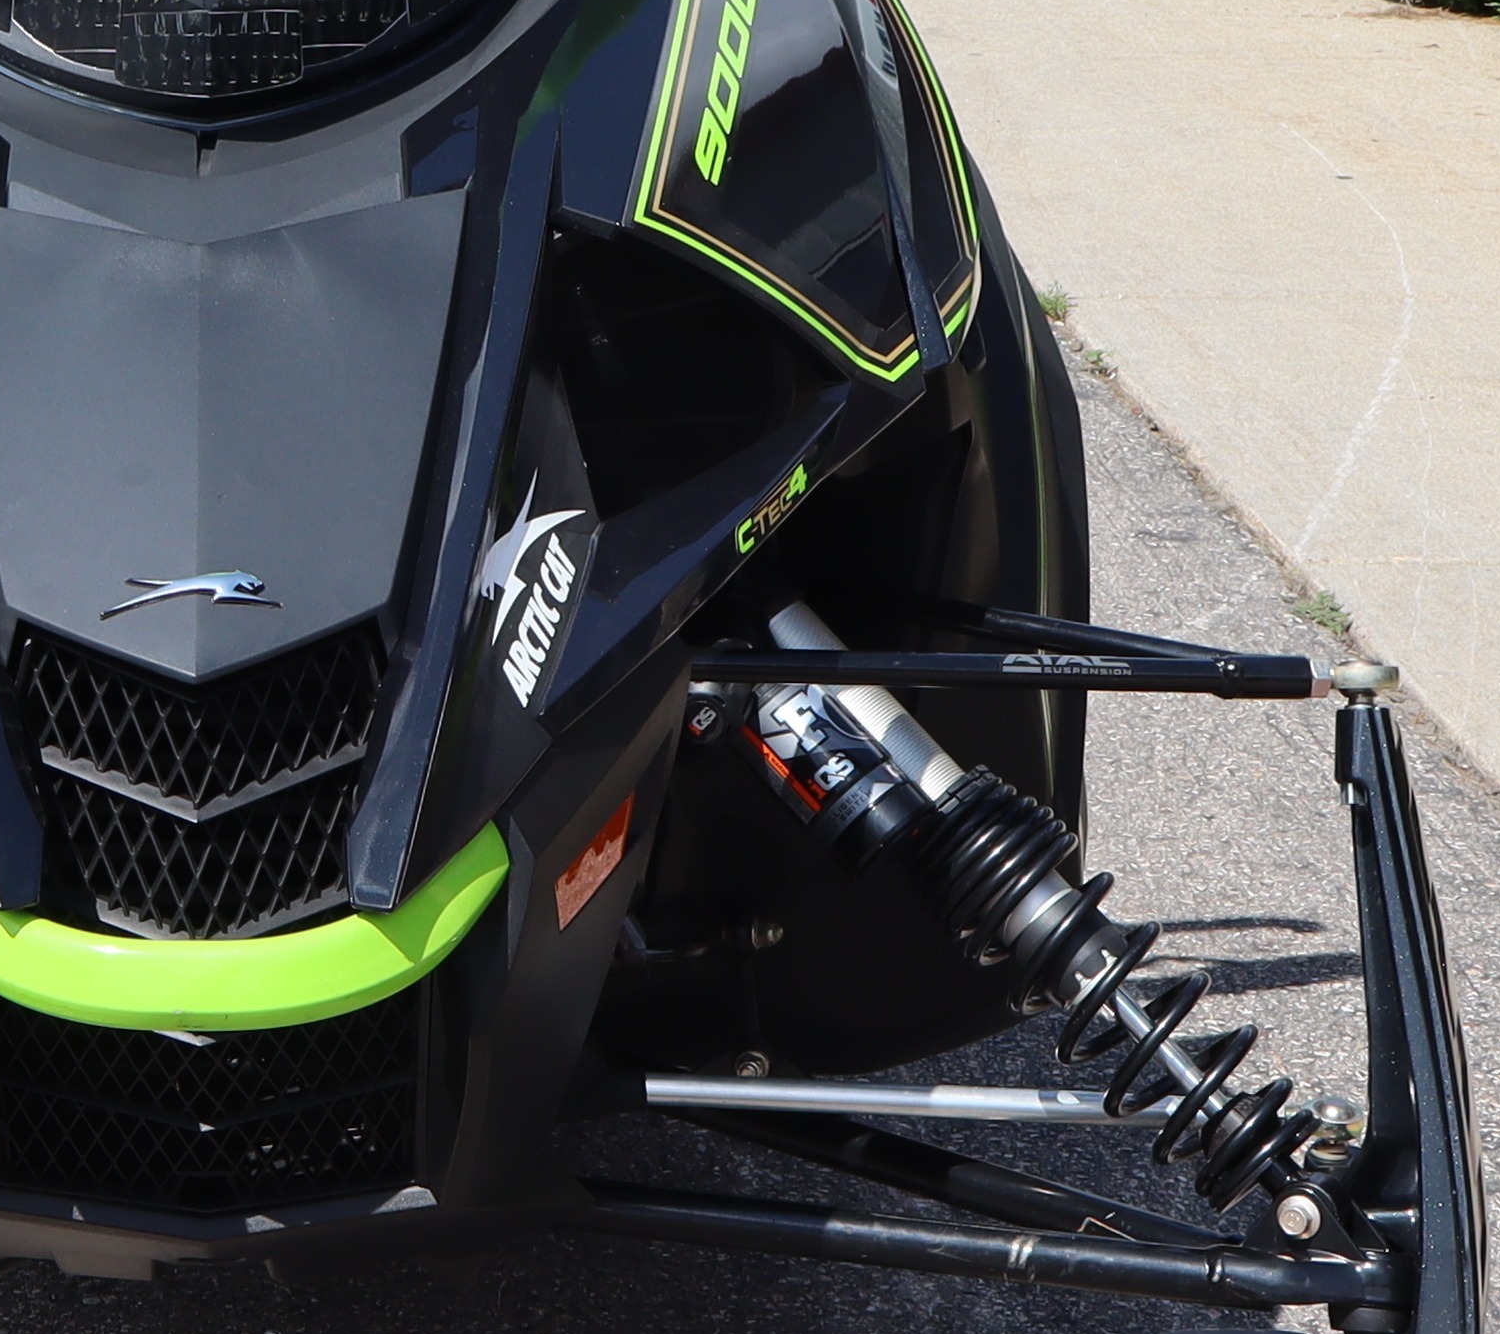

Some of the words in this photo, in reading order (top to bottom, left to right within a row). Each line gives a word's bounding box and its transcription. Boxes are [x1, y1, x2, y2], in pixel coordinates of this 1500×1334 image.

[502, 581, 561, 709] ARCTIC
[540, 532, 576, 603] CAT
[1042, 667, 1132, 676] SUSPENSION
